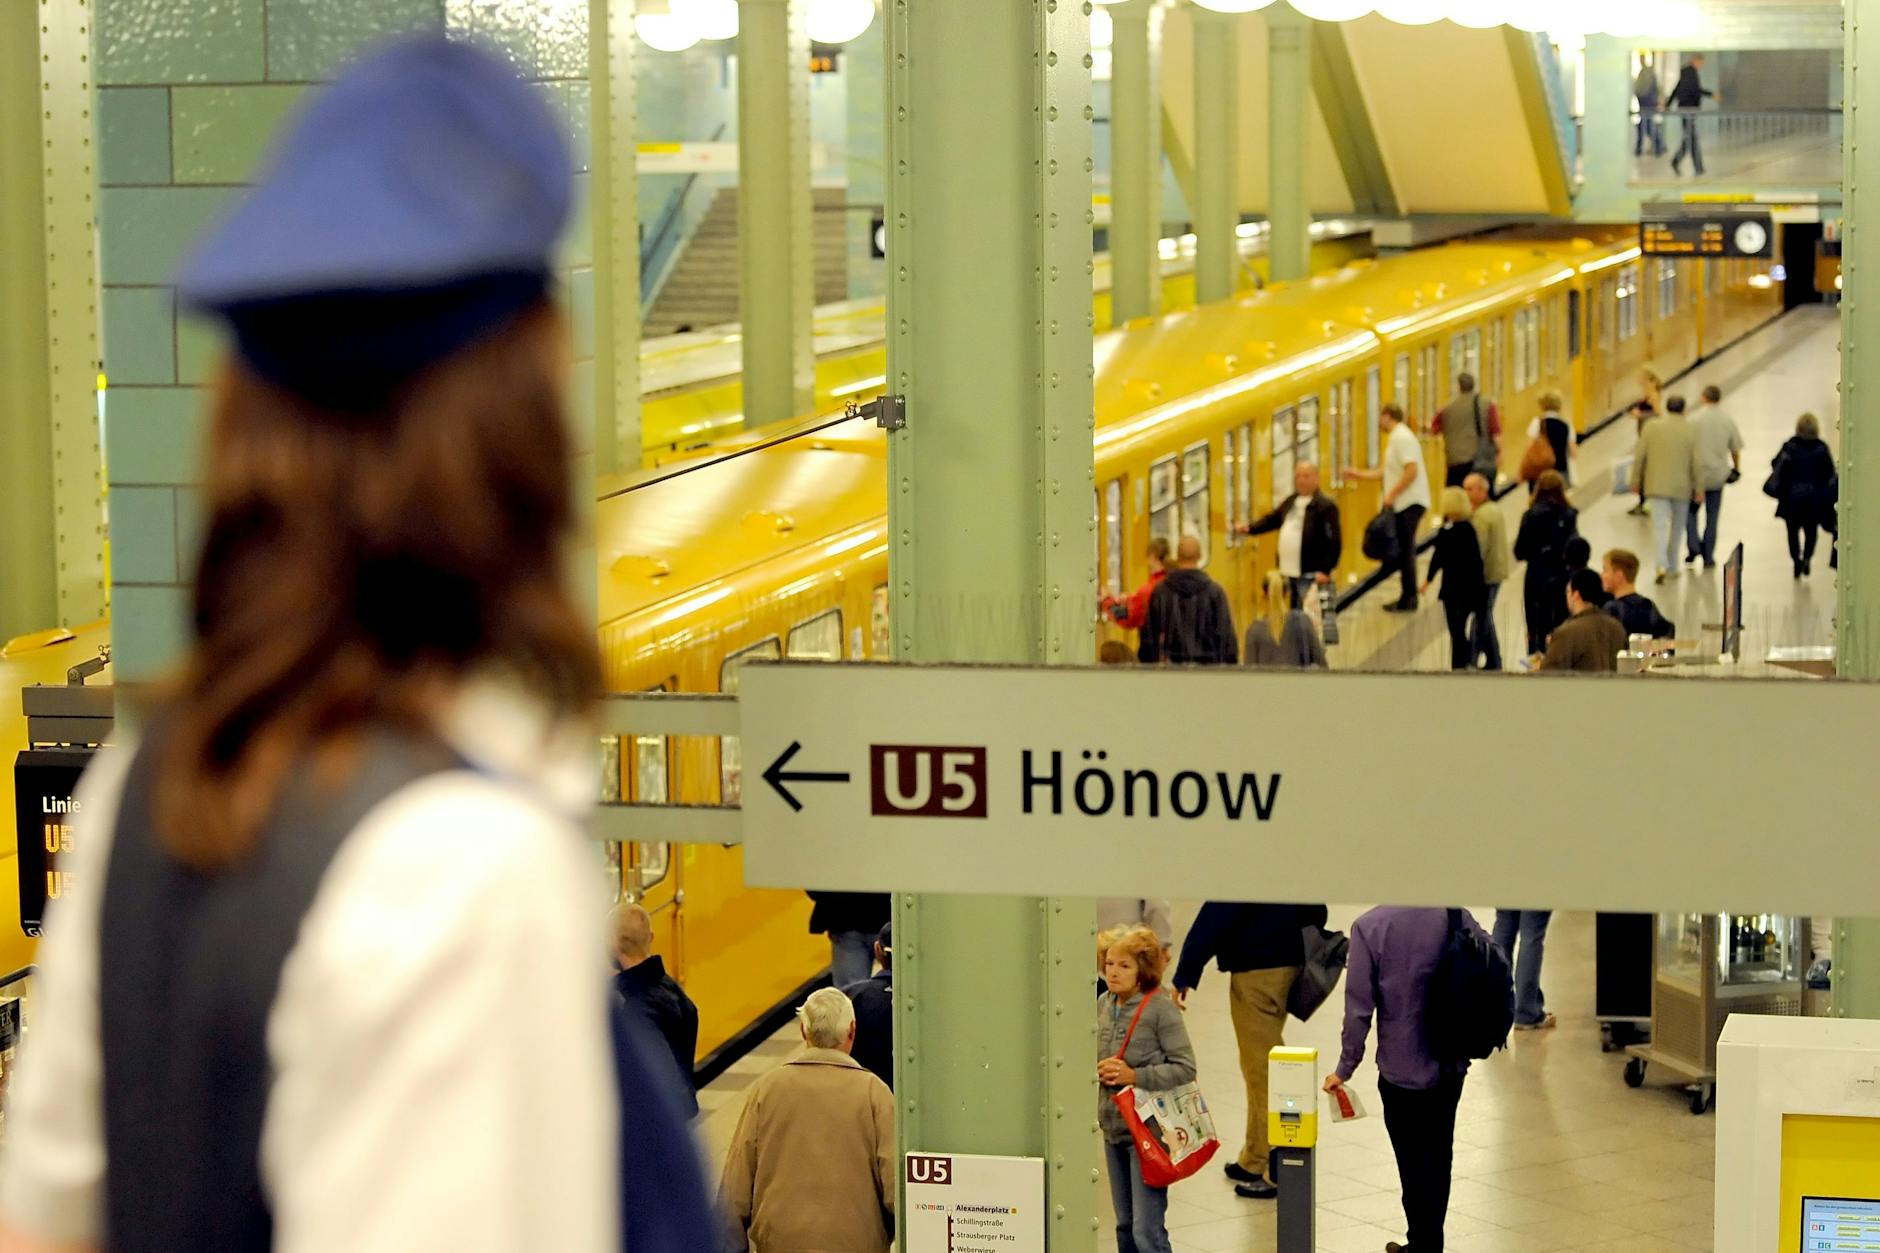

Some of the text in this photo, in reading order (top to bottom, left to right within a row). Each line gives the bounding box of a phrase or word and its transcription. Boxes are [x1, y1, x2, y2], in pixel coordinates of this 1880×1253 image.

[882, 749, 1282, 822] U5 Hönow
[42, 796, 81, 813] Linie
[45, 824, 74, 853] U5
[911, 1158, 948, 1183] U5
[956, 1204, 1009, 1215] Alexanderplatz
[956, 1218, 1004, 1227] Schillingstraße
[956, 1232, 1016, 1242] Strausberger Platz
[957, 1245, 996, 1253] Weberwiese
